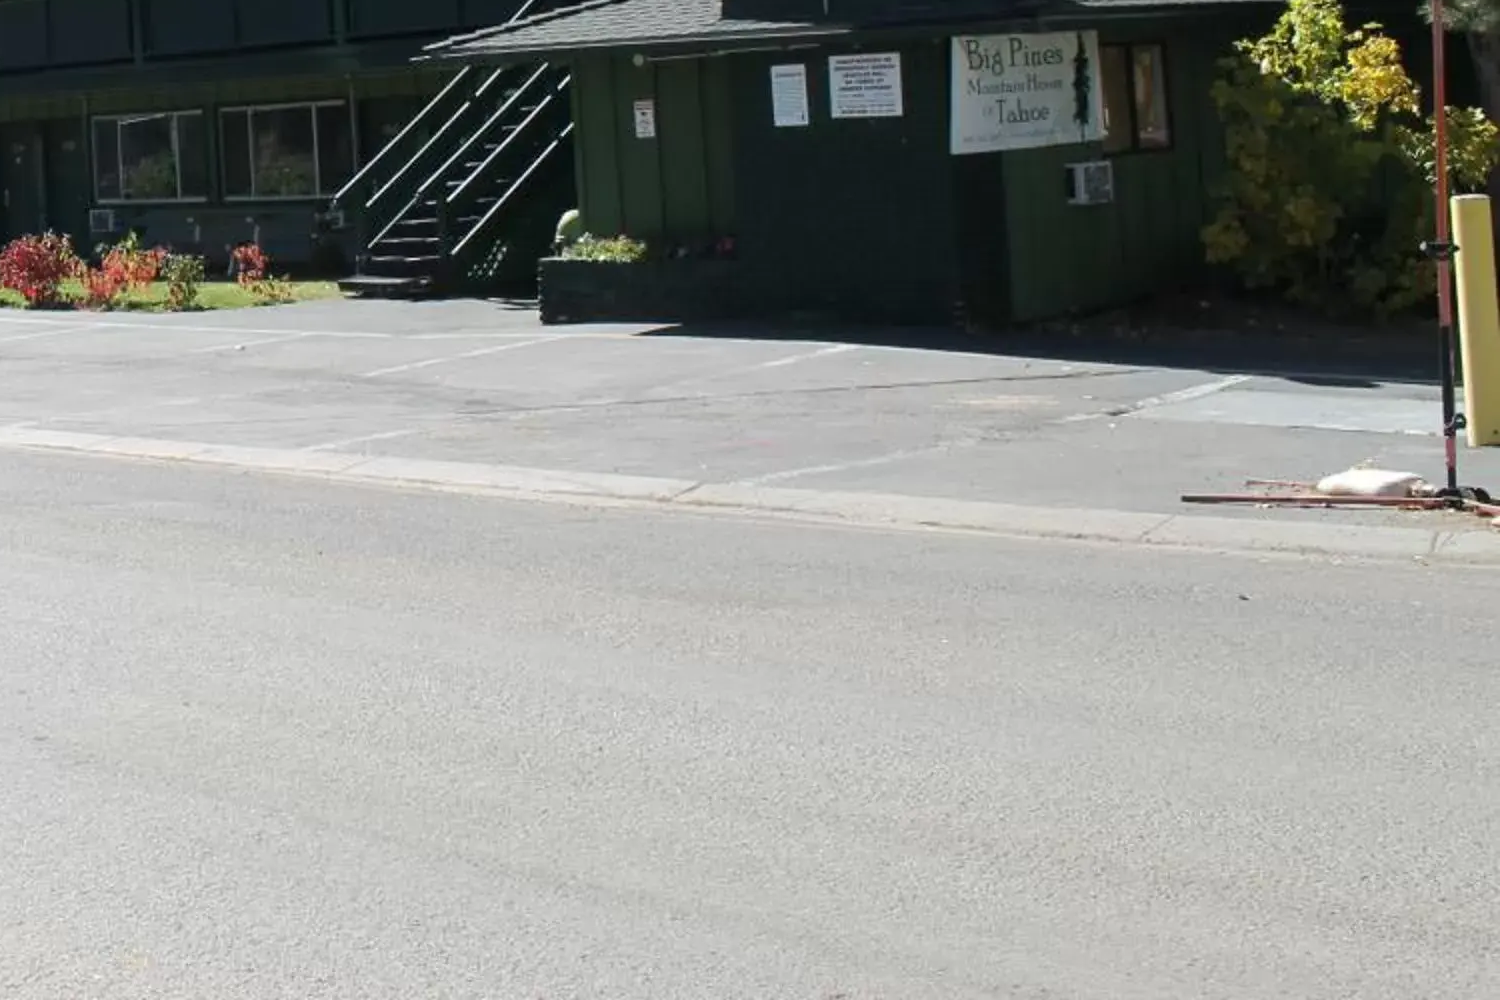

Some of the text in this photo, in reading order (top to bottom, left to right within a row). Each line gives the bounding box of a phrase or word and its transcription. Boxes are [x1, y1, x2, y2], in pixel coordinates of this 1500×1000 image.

[966, 37, 1064, 76] Big Pines
[995, 96, 1050, 124] Tahoe
